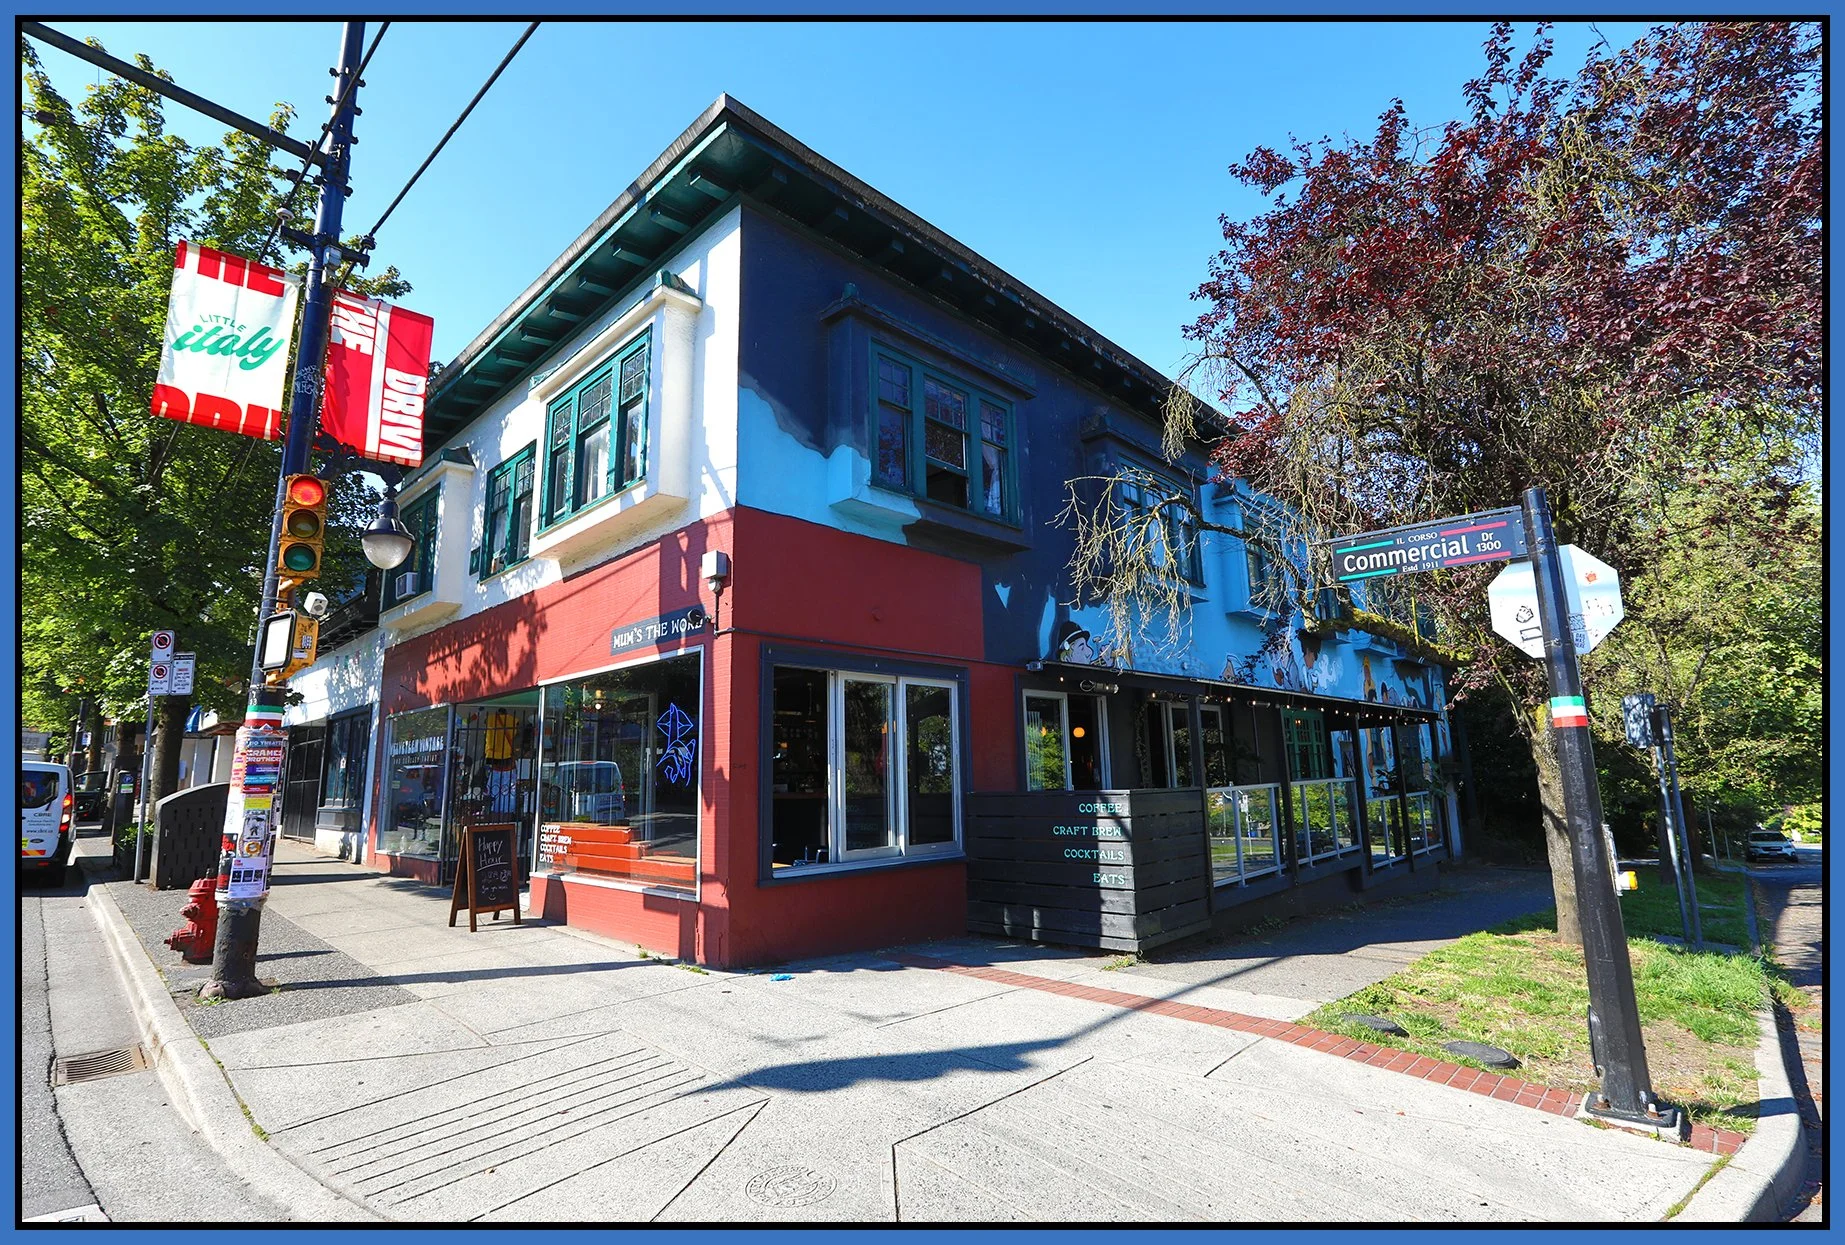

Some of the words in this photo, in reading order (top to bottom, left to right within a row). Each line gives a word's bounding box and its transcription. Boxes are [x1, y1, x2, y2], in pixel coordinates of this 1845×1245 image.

[200, 314, 246, 332] LITTLE
[331, 295, 378, 356] THE
[172, 324, 285, 370] italy
[1407, 531, 1438, 543] CORSO
[1481, 532, 1494, 542] Dr
[1343, 534, 1470, 572] Commercial
[1475, 540, 1502, 553] 1300
[1402, 565, 1418, 573] Estd
[1422, 560, 1439, 569] 1911
[613, 627, 643, 648] MUM'S
[645, 622, 668, 640] THE
[1078, 803, 1123, 813] COFFEE
[540, 824, 561, 834] COFFEE
[1052, 825, 1088, 836] CRAFT
[1092, 826, 1122, 837] BREW
[478, 836, 503, 855] Happy
[540, 843, 568, 854] COCKTAILS
[479, 853, 503, 868] Hour
[539, 853, 554, 864] EATS
[1063, 848, 1124, 861] COCKTAILS
[1092, 872, 1126, 885] EATS
